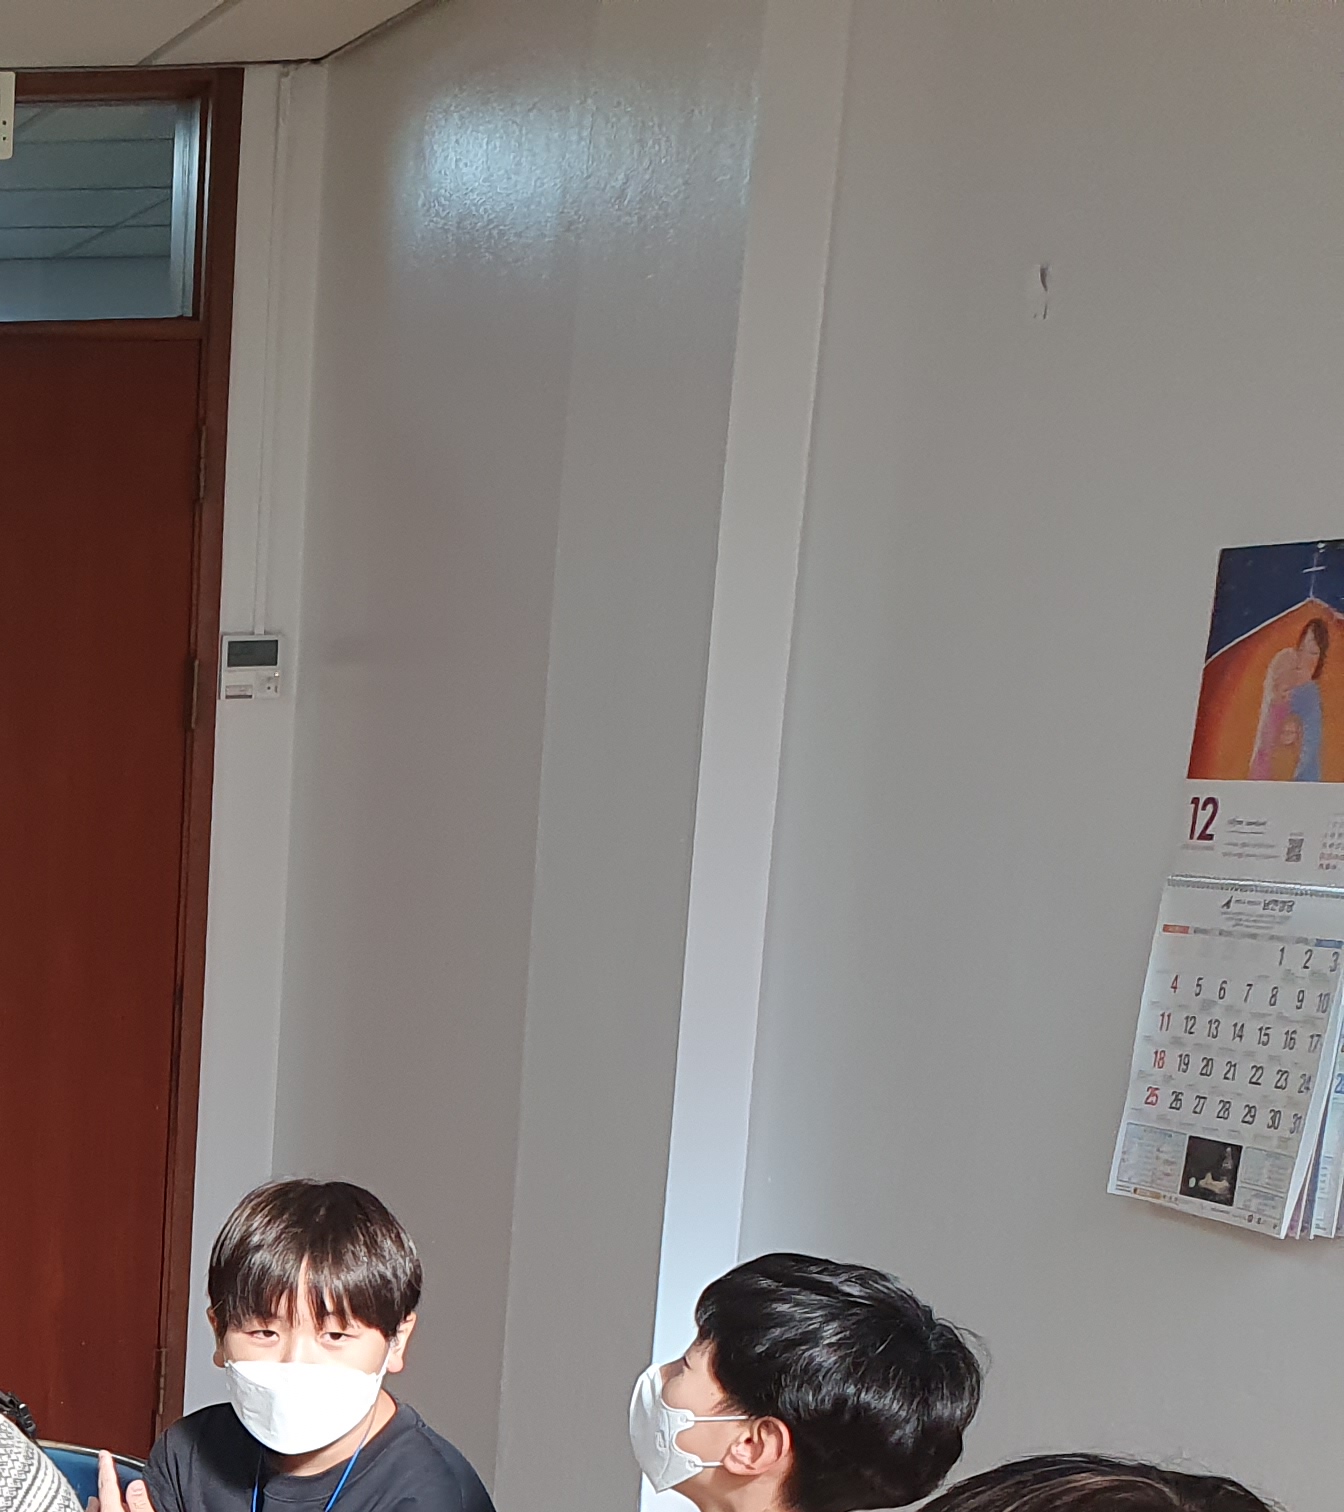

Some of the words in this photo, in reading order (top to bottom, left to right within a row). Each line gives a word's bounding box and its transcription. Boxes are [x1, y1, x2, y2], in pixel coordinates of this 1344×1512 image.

[1189, 796, 1220, 841] 12
[1277, 946, 1286, 967] 1
[1302, 948, 1314, 970] 2
[1328, 951, 1340, 973] 3
[1170, 974, 1179, 994] 4
[1194, 976, 1205, 997] 5
[1218, 980, 1228, 1000] 6
[1243, 983, 1254, 1003] 7
[1268, 986, 1279, 1007] 8
[1295, 989, 1305, 1010] 9
[1315, 992, 1331, 1014] 10
[1159, 1011, 1172, 1032] 11
[1183, 1015, 1197, 1035] 12
[1207, 1018, 1221, 1039] 13
[1231, 1022, 1246, 1042] 14
[1257, 1025, 1273, 1047] 15
[1282, 1029, 1298, 1051] 16
[1307, 1033, 1323, 1054] 17
[1153, 1049, 1166, 1069] 18
[1177, 1053, 1191, 1074] 19
[1199, 1056, 1214, 1077] 20
[1223, 1060, 1237, 1081] 21
[1248, 1064, 1264, 1086] 22
[1273, 1069, 1290, 1091] 23
[1297, 1073, 1312, 1094] 24
[1144, 1086, 1161, 1106] 25
[1168, 1090, 1185, 1111] 26
[1192, 1094, 1208, 1115] 27
[1215, 1099, 1232, 1120] 28
[1240, 1103, 1258, 1126] 29
[1266, 1108, 1282, 1131] 30
